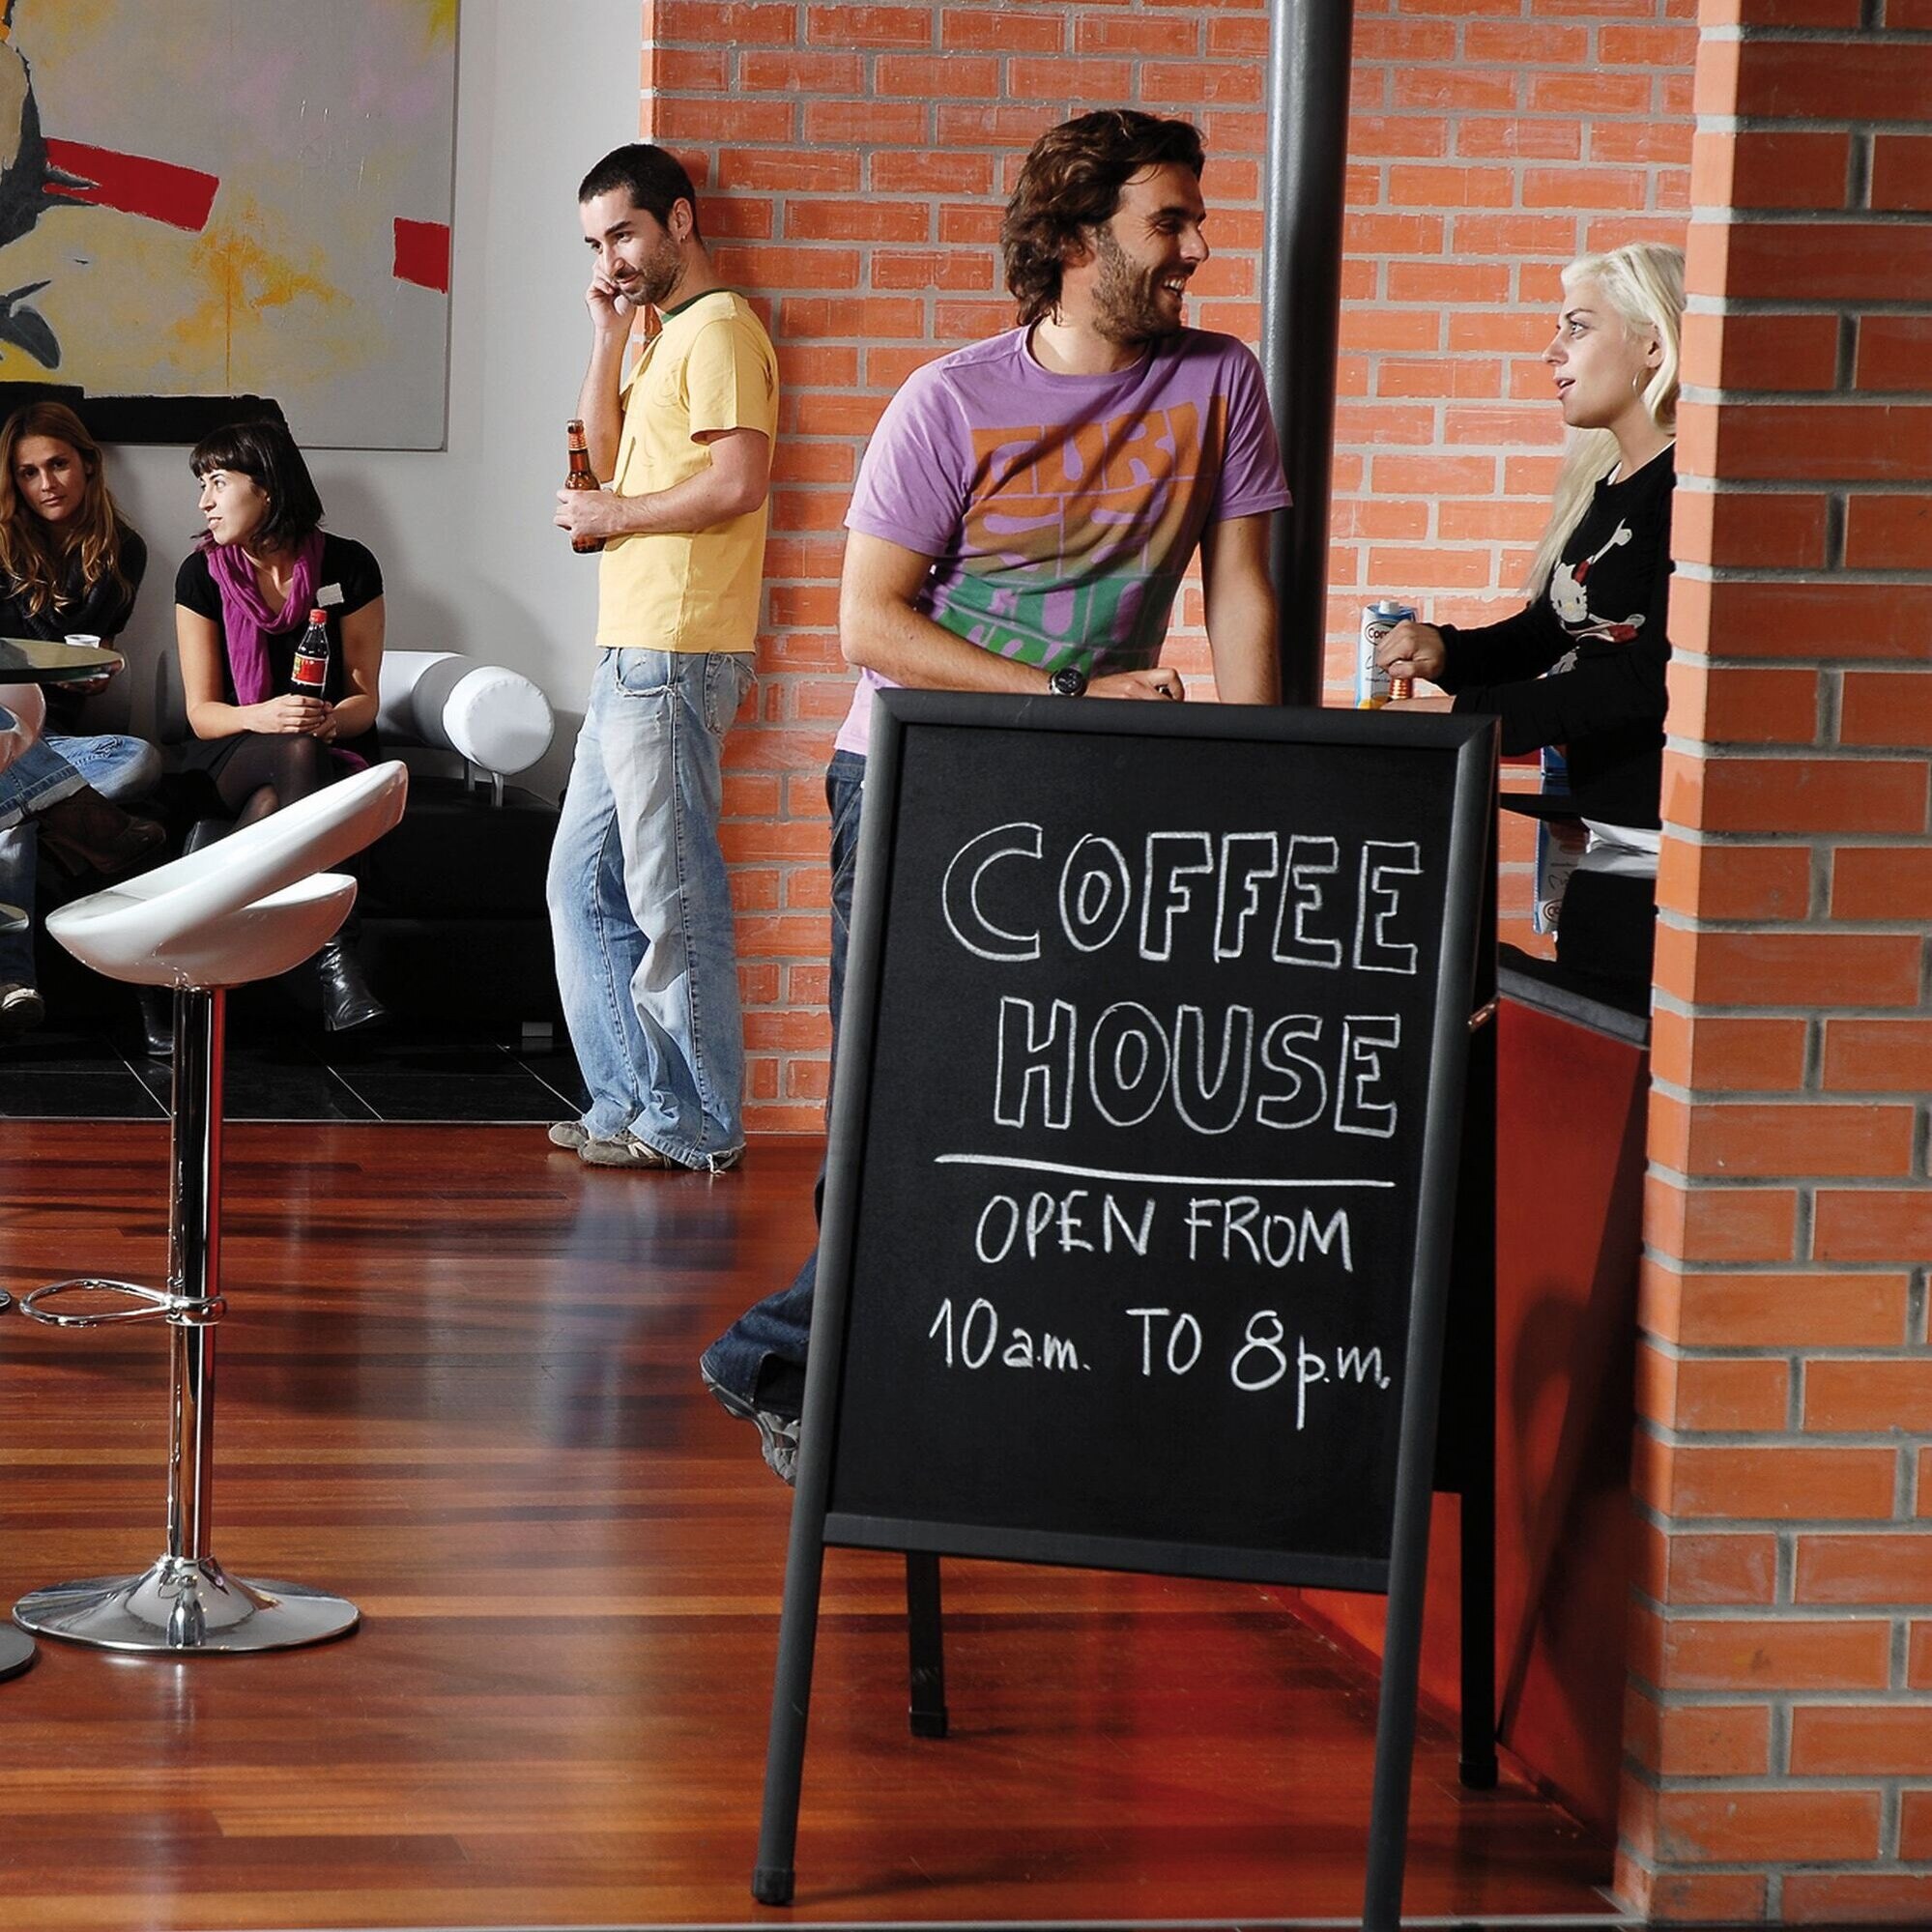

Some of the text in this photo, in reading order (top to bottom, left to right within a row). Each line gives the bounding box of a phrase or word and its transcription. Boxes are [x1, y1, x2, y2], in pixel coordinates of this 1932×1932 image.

[941, 822, 1424, 975] COFFEE
[994, 995, 1401, 1139] HOUSE
[975, 1190, 1353, 1272] OPEN FROM
[1125, 1308, 1202, 1376] TO
